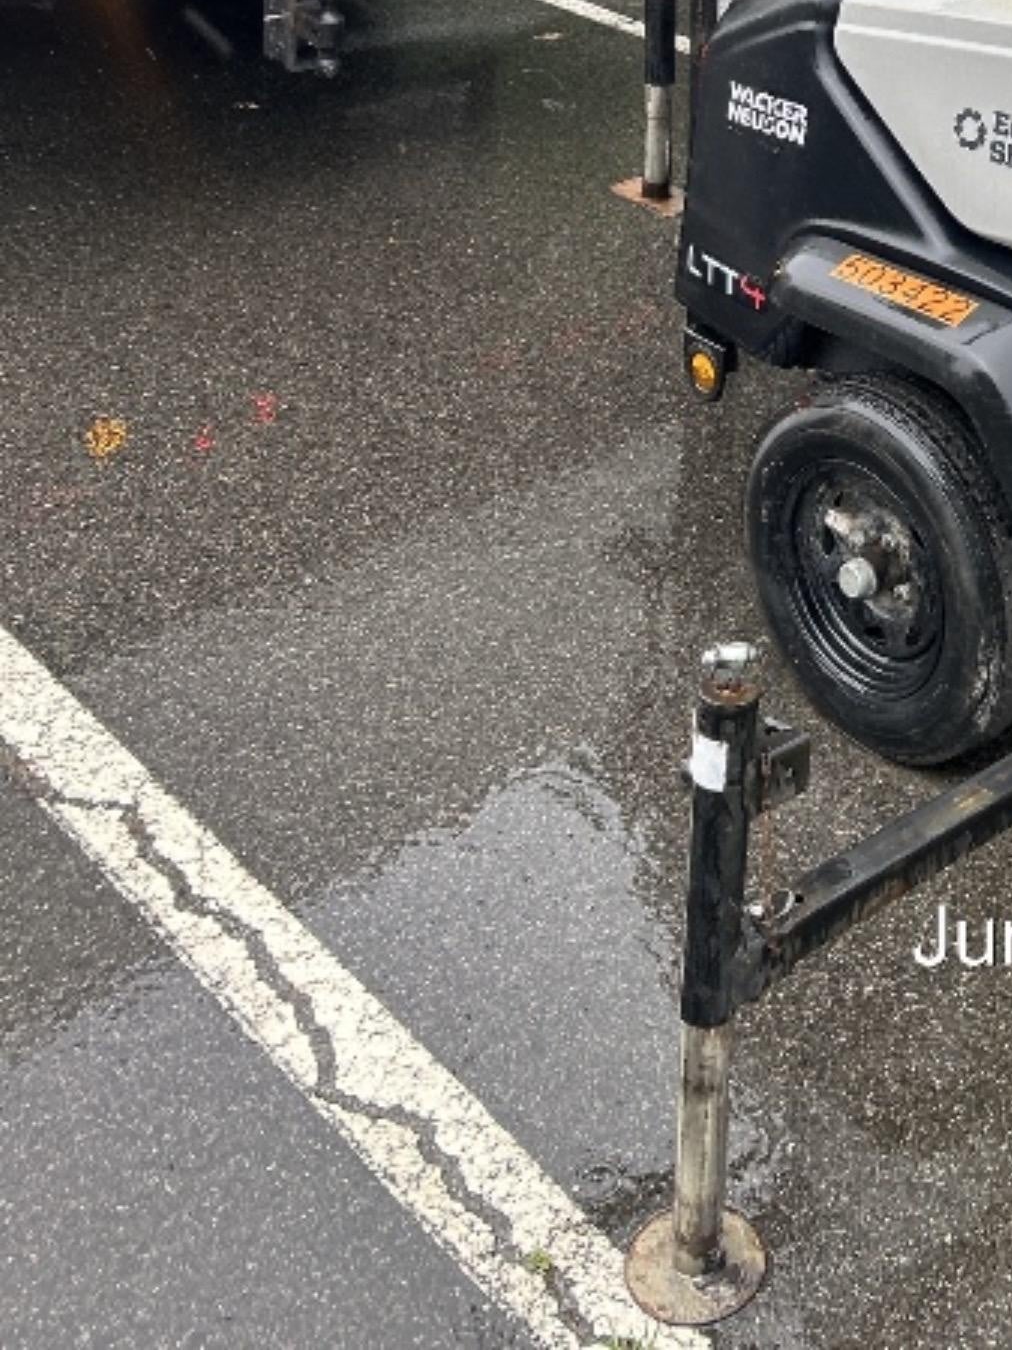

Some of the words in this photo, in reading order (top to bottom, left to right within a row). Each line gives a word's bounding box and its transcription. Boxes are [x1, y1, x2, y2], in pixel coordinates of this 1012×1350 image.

[727, 101, 806, 146] NEUSON
[729, 79, 808, 128] WACKER
[686, 244, 766, 310] LTT4
